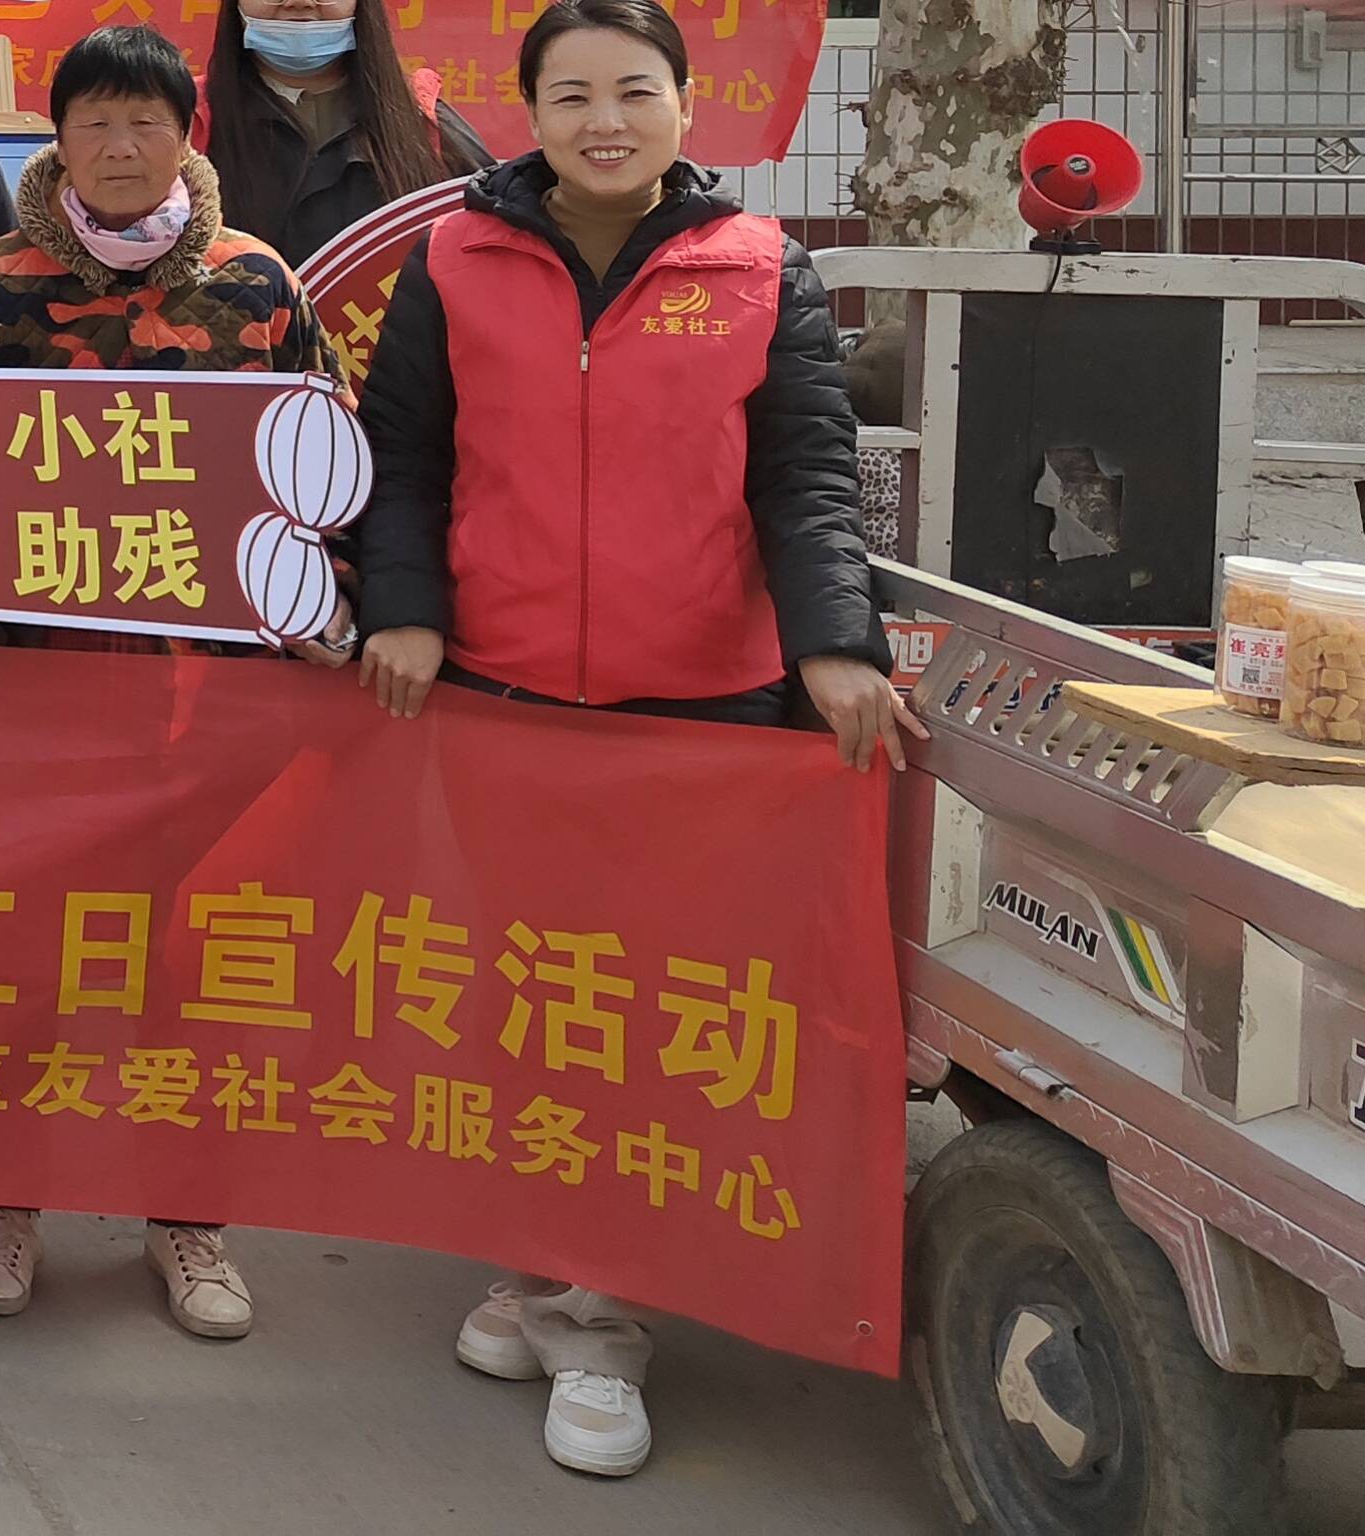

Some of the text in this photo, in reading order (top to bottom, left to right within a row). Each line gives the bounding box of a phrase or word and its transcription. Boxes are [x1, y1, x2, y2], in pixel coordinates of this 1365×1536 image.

[640, 315, 731, 336] 友爱社工
[5, 388, 196, 485] 小社
[12, 506, 207, 608] 助残
[983, 882, 1102, 961] MULAN
